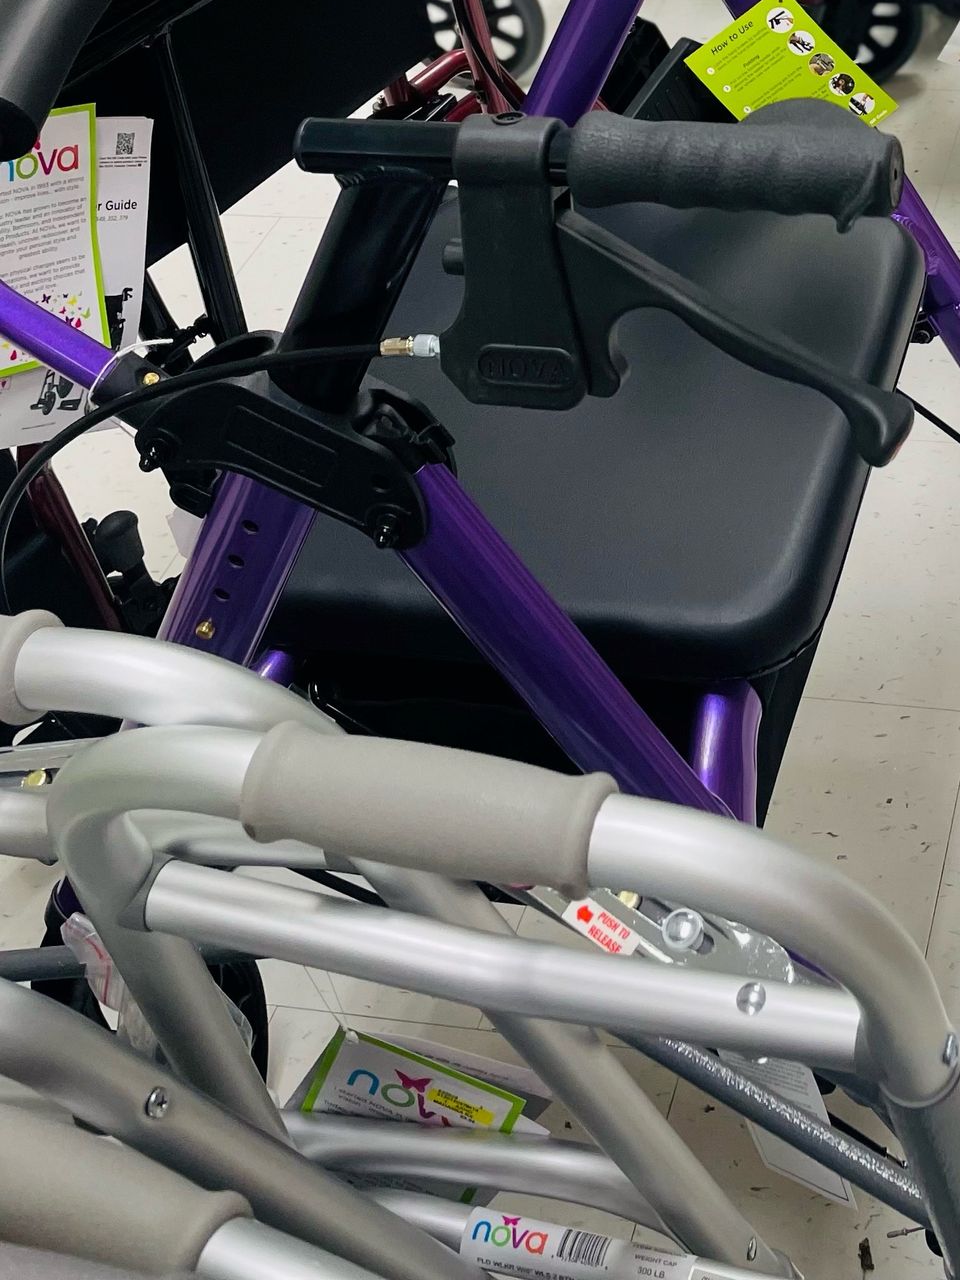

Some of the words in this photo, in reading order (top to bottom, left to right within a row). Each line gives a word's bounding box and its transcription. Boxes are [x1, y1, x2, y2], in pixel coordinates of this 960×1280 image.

[711, 40, 728, 55] How
[729, 33, 738, 42] to
[738, 21, 753, 34] Use
[105, 199, 138, 211] Guide
[588, 925, 622, 953] RELEASE
[597, 911, 620, 932] PUSH
[618, 927, 631, 940] TO
[347, 1069, 451, 1128] nov
[472, 1220, 548, 1255] nova
[635, 1253, 661, 1265] WEIGHT
[663, 1259, 677, 1267] CAP
[637, 1266, 653, 1276] 300
[654, 1270, 665, 1279] LB
